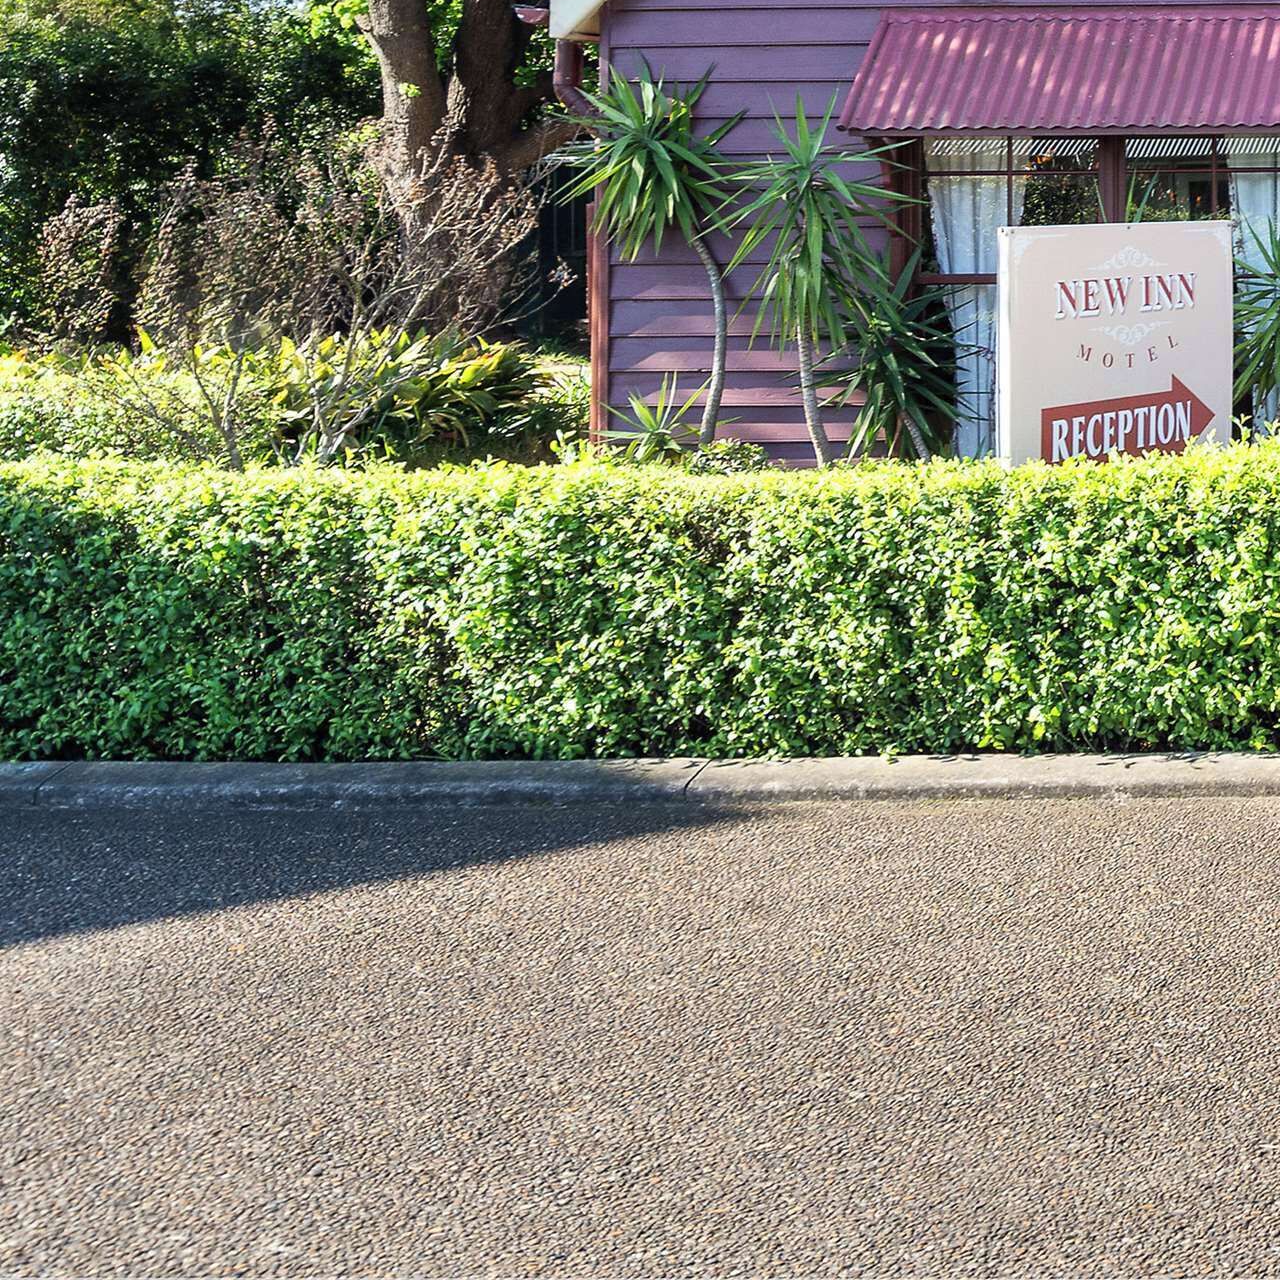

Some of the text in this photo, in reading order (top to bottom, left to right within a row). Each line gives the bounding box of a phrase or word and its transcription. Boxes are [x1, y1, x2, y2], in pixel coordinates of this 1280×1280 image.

[1055, 272, 1197, 320] NEW INN
[1077, 335, 1179, 368] MOTEL
[1052, 400, 1191, 463] RECEPTION
